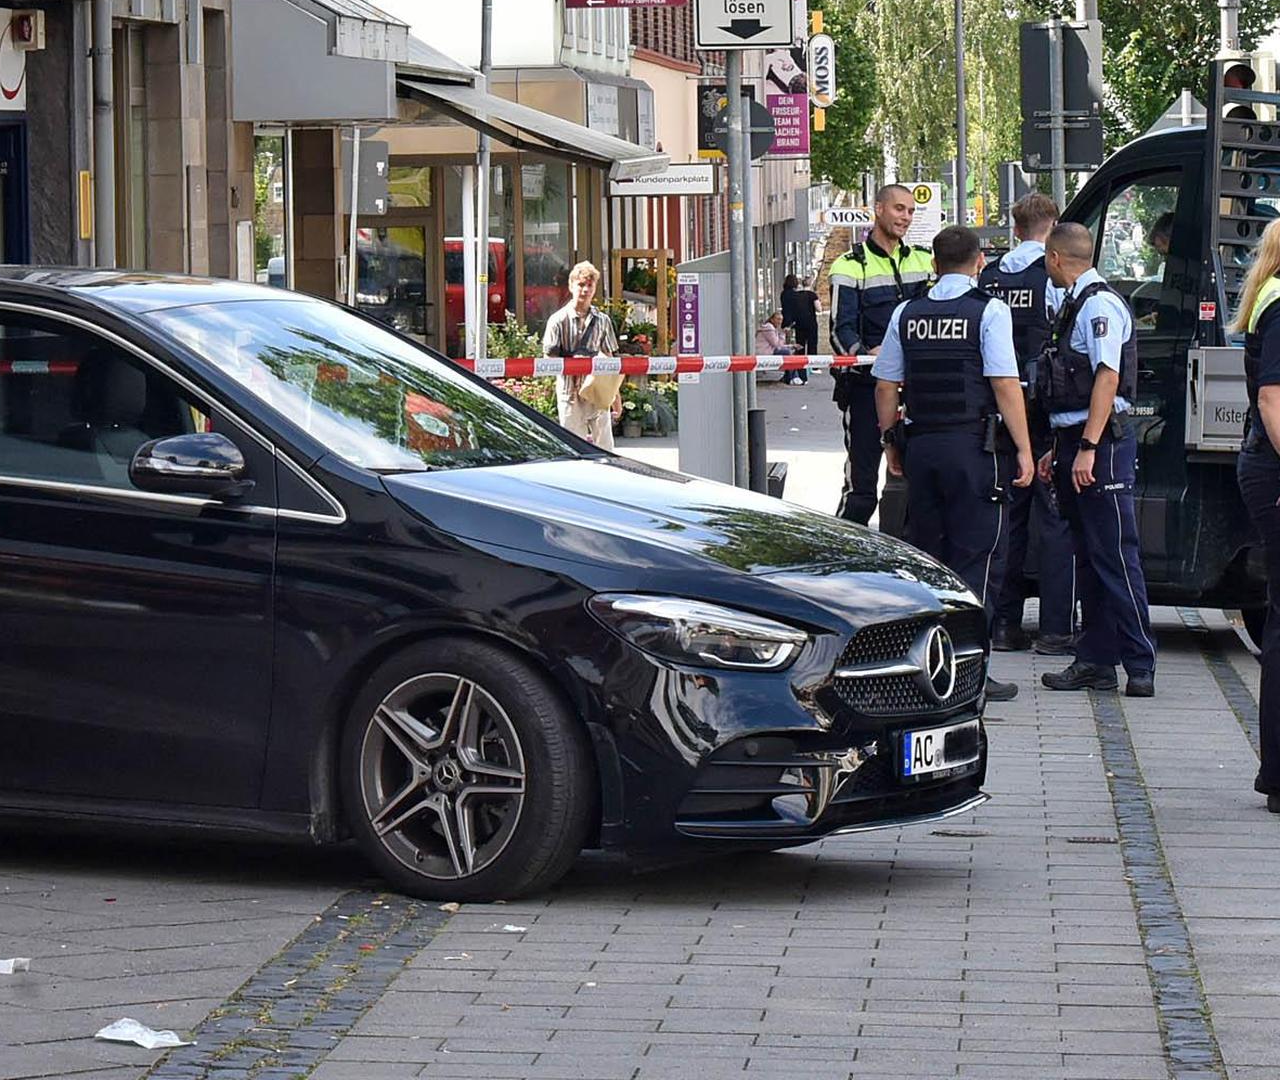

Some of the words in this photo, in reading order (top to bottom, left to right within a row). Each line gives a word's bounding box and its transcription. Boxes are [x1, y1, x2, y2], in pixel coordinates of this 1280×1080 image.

[724, 0, 765, 14] lösen
[816, 46, 829, 96] MOSS
[635, 175, 709, 184] Kundenparkplatz
[831, 211, 870, 223] MOSS
[907, 319, 968, 340] POLIZEI
[913, 735, 934, 769] AC
